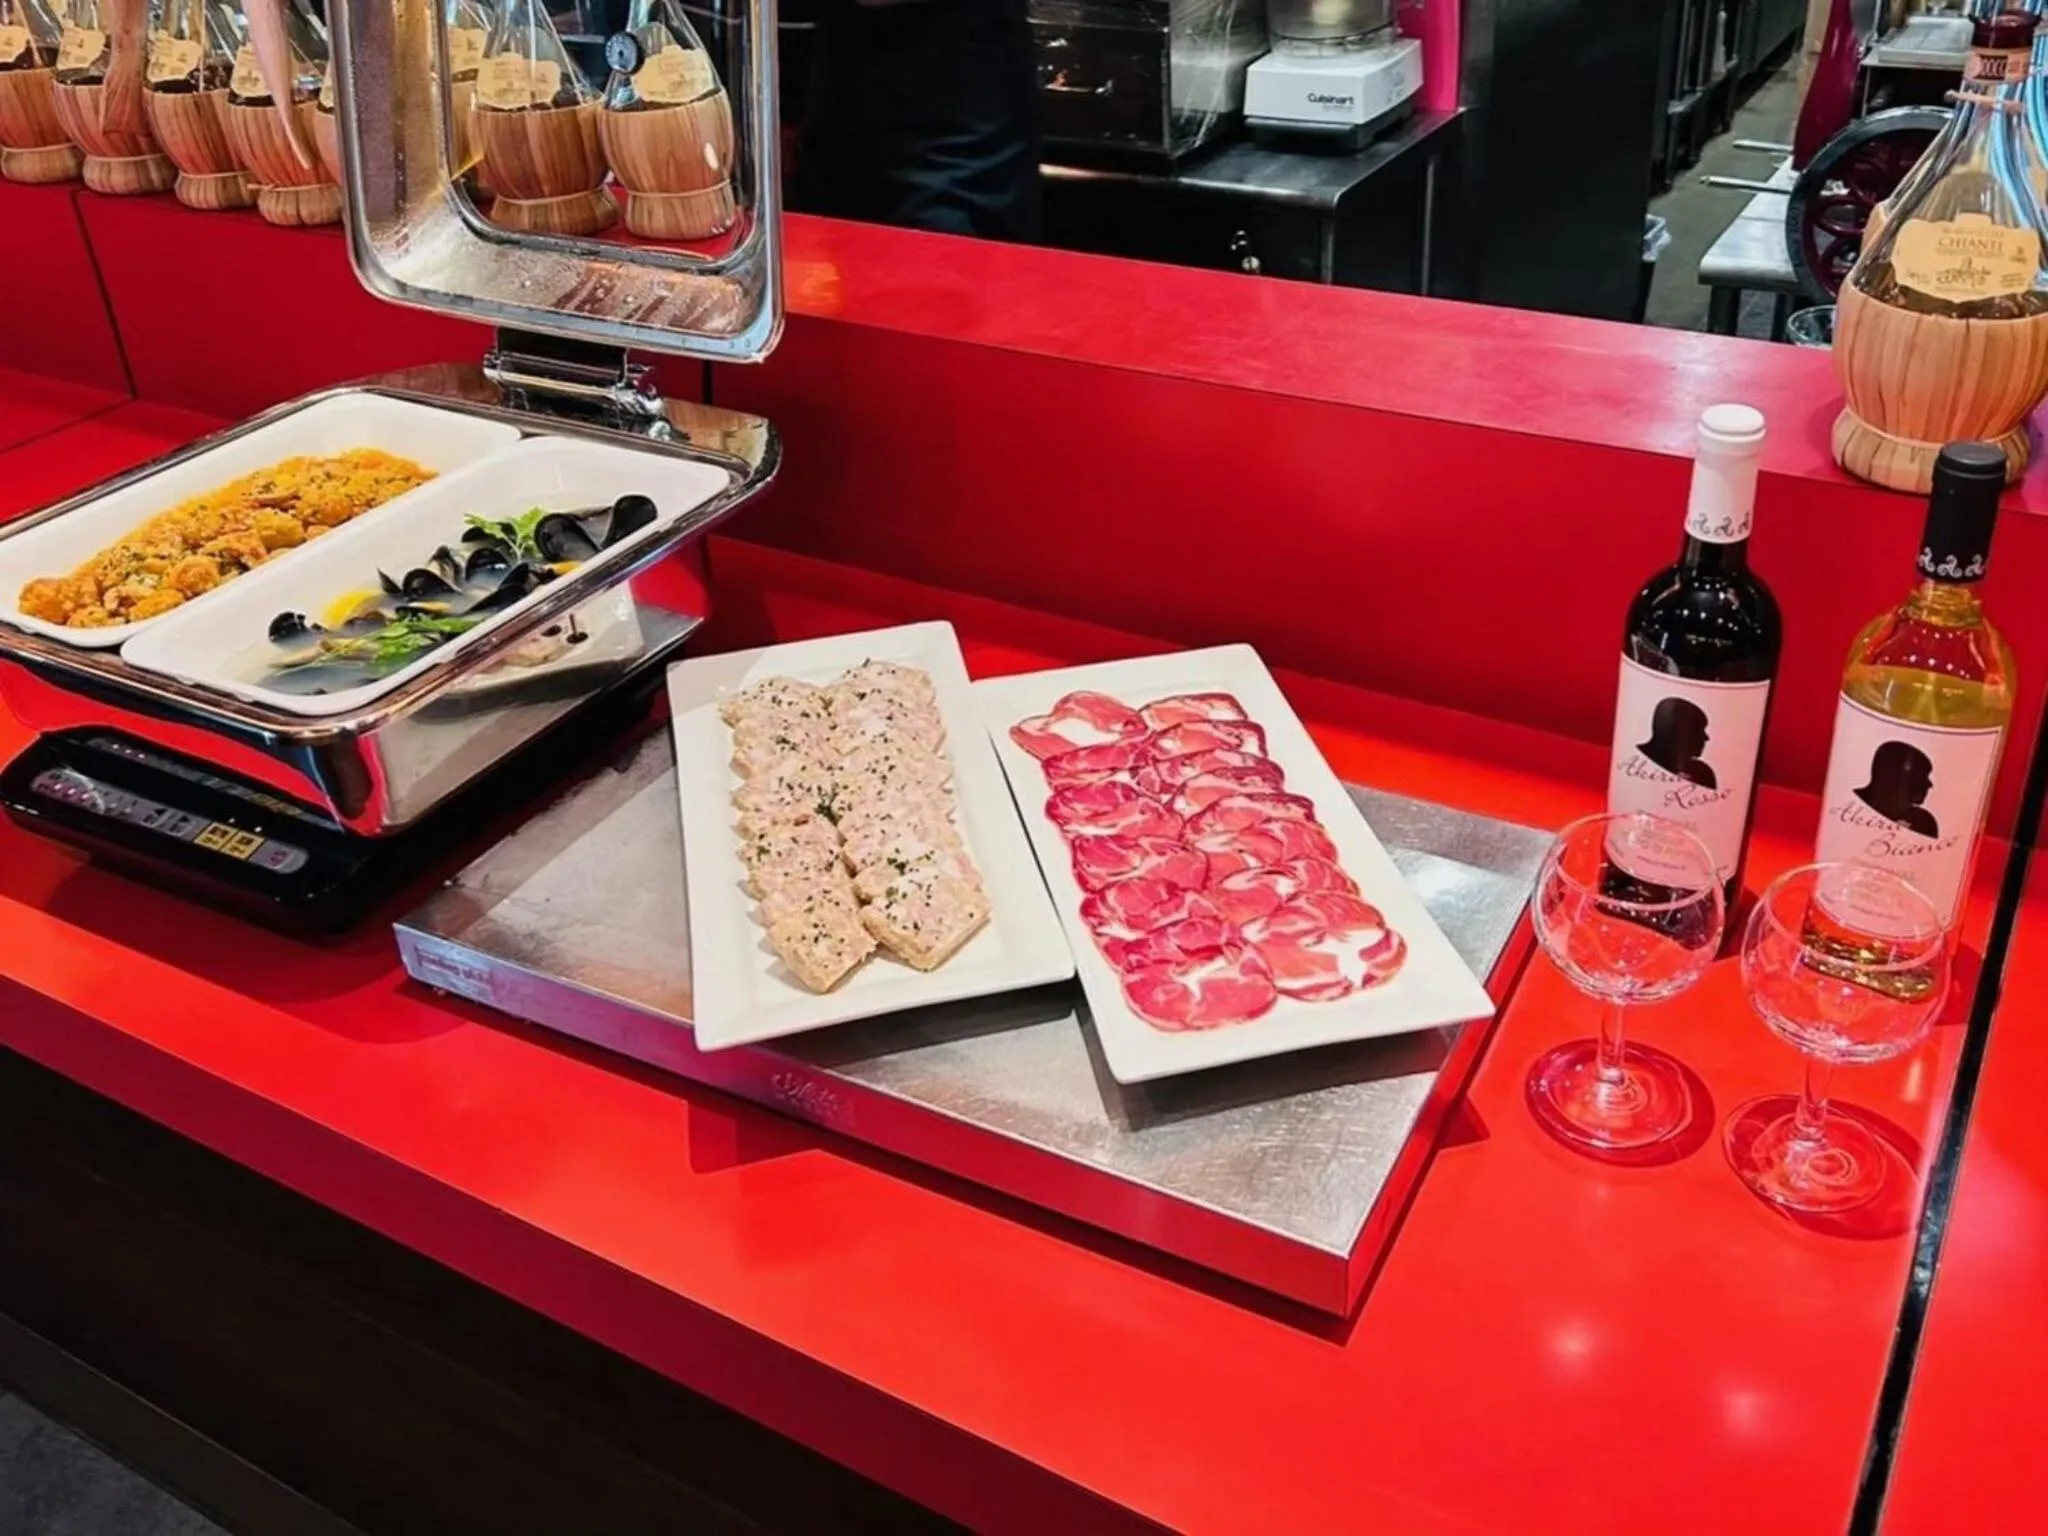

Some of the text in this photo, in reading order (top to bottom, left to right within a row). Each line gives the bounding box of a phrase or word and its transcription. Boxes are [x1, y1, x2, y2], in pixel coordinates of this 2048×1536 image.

[1307, 92, 1354, 105] Cuisinart
[1938, 237, 2003, 251] CHIANTI
[1663, 784, 1733, 809] Rosso
